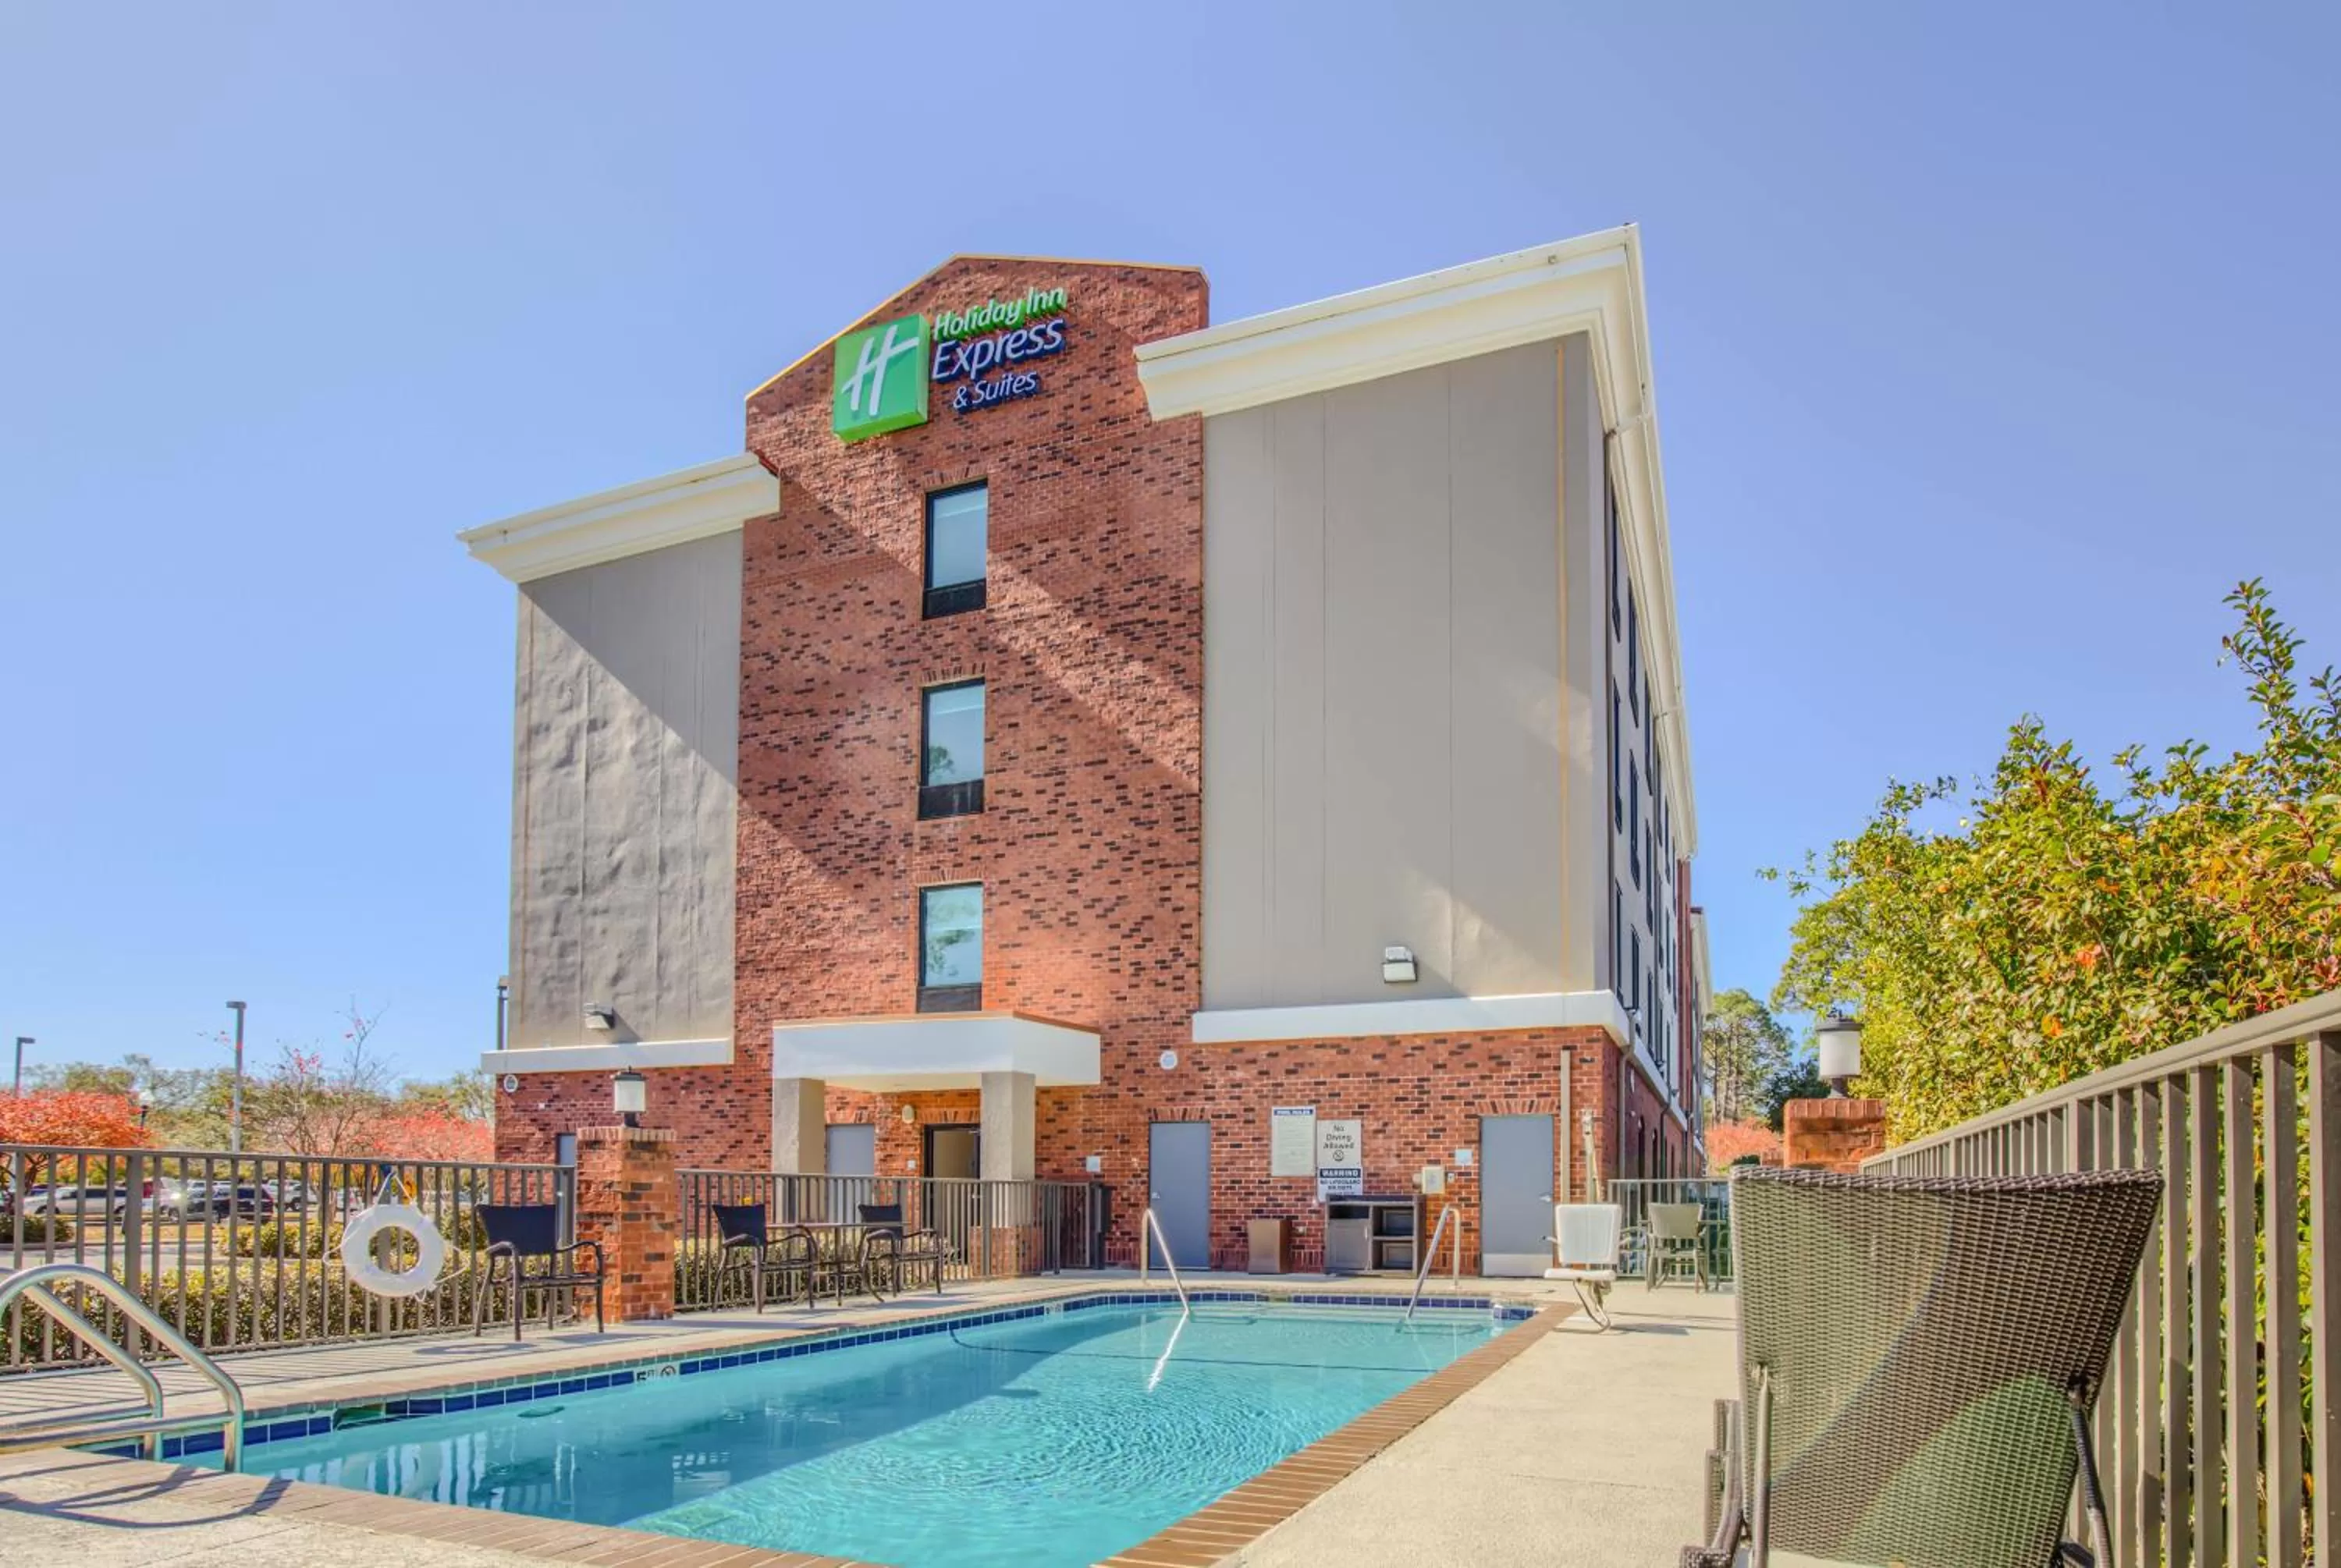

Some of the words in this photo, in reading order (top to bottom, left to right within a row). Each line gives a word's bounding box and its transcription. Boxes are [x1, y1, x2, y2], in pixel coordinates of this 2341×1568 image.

[933, 296, 1025, 340] Holiday
[1026, 286, 1067, 314] Inn
[932, 318, 1066, 382] Express
[952, 386, 968, 413] &
[971, 371, 1041, 407] Suites
[1326, 1133, 1352, 1142] Diving
